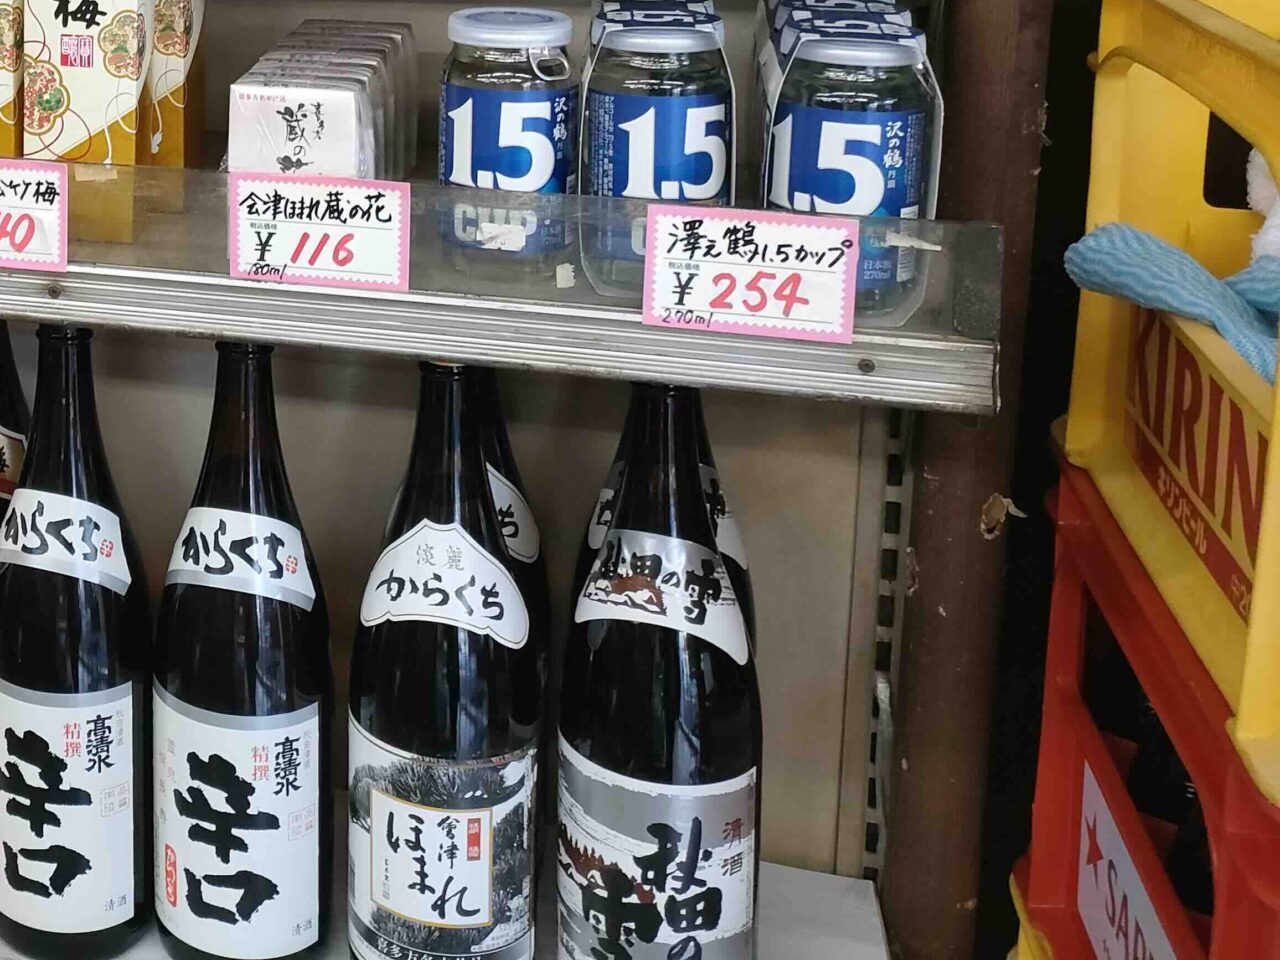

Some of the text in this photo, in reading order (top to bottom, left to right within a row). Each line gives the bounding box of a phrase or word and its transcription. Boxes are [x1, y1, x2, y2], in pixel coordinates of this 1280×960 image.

[448, 96, 556, 192] 1.5
[553, 96, 567, 141] 沢の鶴
[883, 121, 903, 169] 沢の鶴
[618, 104, 726, 201] 1.5
[767, 113, 885, 216] 1.5
[4, 500, 101, 563] からくち
[182, 518, 286, 581] からくち
[375, 569, 504, 621] からくち
[64, 722, 82, 758] 精撰
[251, 745, 270, 782] 精撰
[173, 751, 281, 926] 辛口
[387, 812, 480, 919] ほまれ
[721, 818, 744, 876] 清酒
[105, 895, 127, 912] 清酒
[291, 919, 313, 937] 清酒
